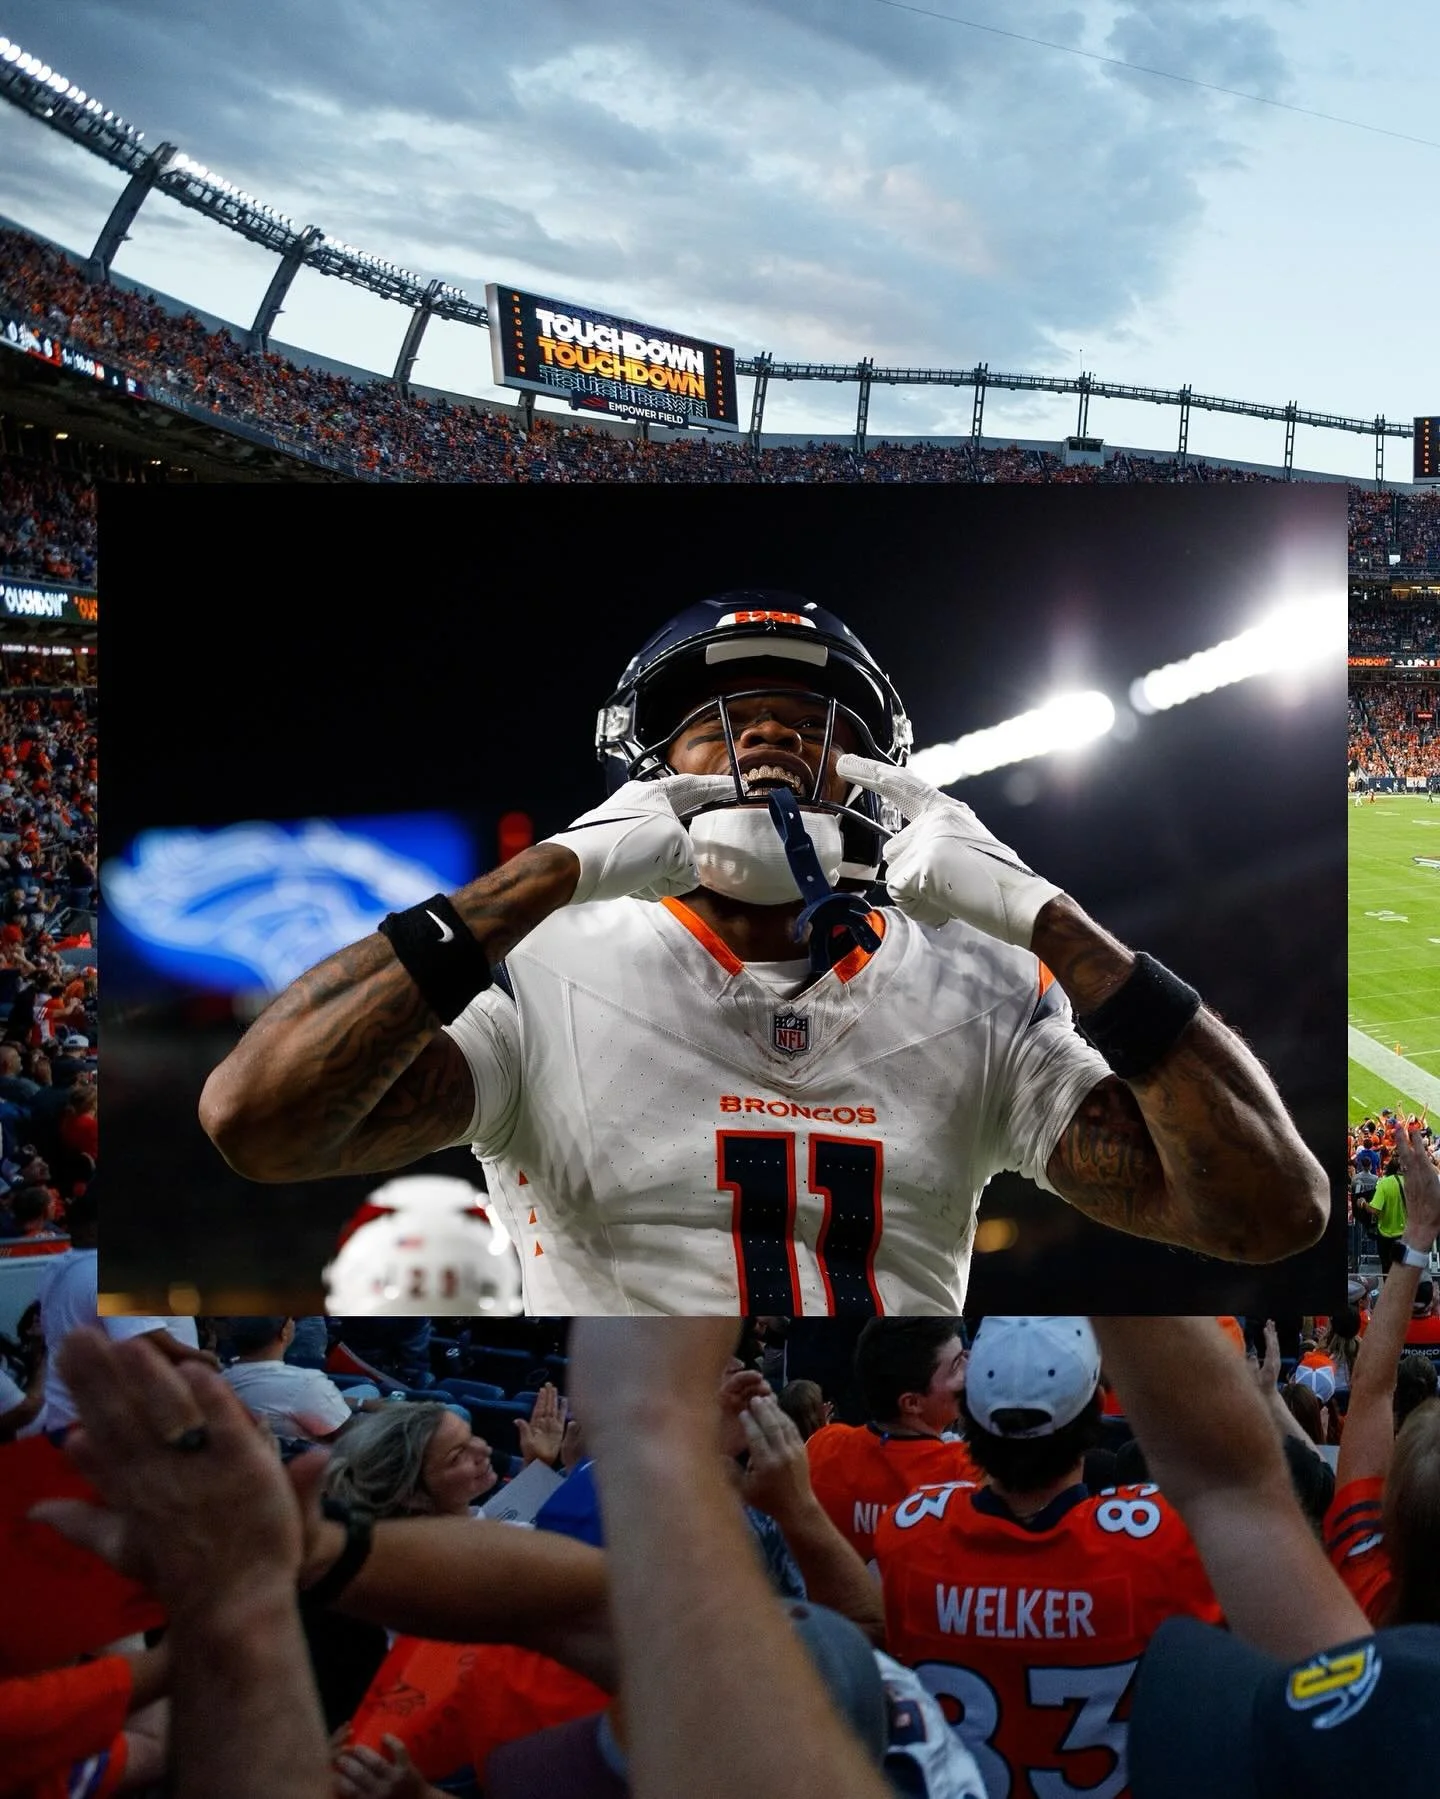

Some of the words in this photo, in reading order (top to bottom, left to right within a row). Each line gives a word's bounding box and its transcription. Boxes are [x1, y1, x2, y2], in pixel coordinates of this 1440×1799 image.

[535, 308, 704, 376] TOUCHDOWN
[537, 335, 706, 400] TOUCHDOWN
[608, 402, 657, 420] EMPOWER
[658, 413, 684, 425] FIELD
[777, 1029, 805, 1050] NFL
[719, 1095, 878, 1125] BRONCOS
[716, 1130, 885, 1317] 11
[854, 1500, 888, 1535] NI
[936, 1583, 1096, 1640] WELKER
